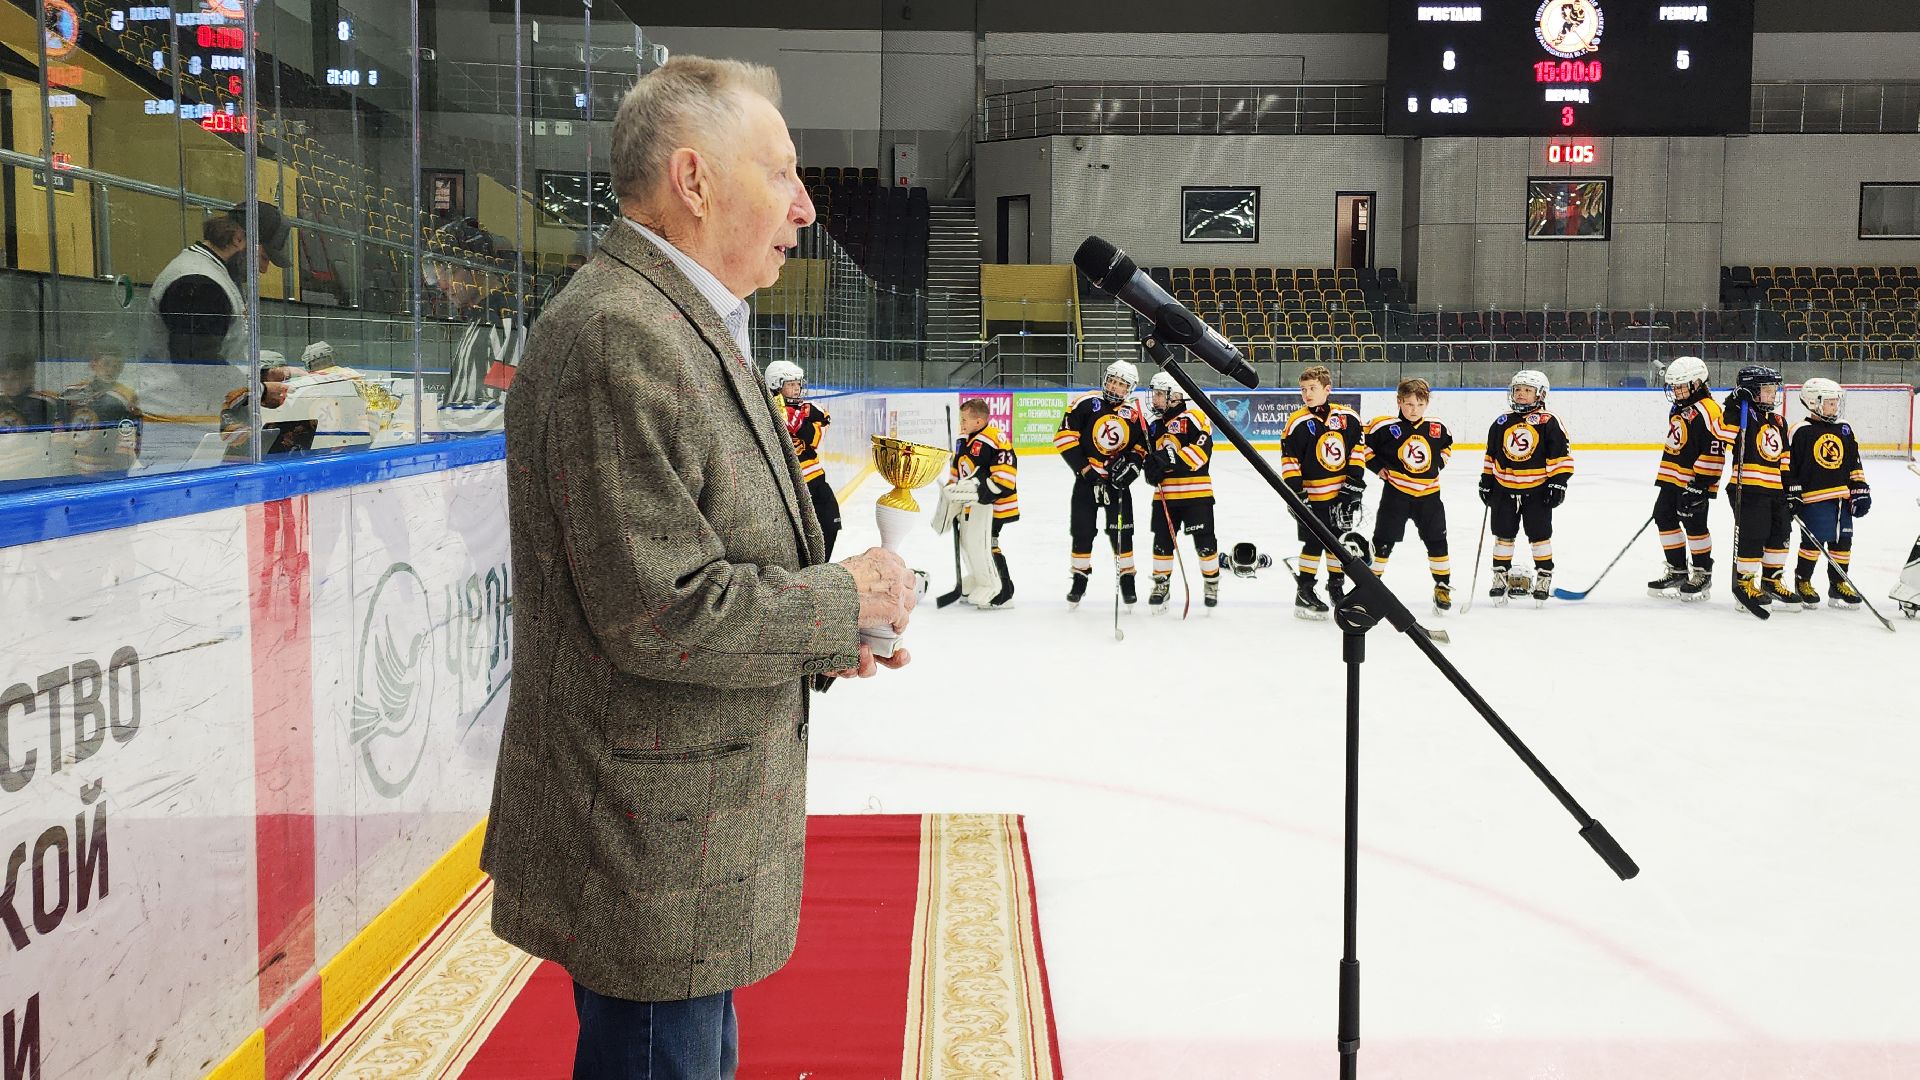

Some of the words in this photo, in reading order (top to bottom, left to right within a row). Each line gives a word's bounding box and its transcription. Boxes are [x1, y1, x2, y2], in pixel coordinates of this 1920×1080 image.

[1443, 51, 1455, 70] 8
[1677, 51, 1689, 70] 5
[1533, 61, 1602, 82] 15:00:0
[1408, 98, 1418, 113] 5
[1431, 98, 1468, 114] 00:15
[1561, 106, 1574, 127] 3
[1276, 403, 1305, 411] ФИГУРН
[1196, 433, 1207, 446] 8
[997, 451, 1013, 465] 33
